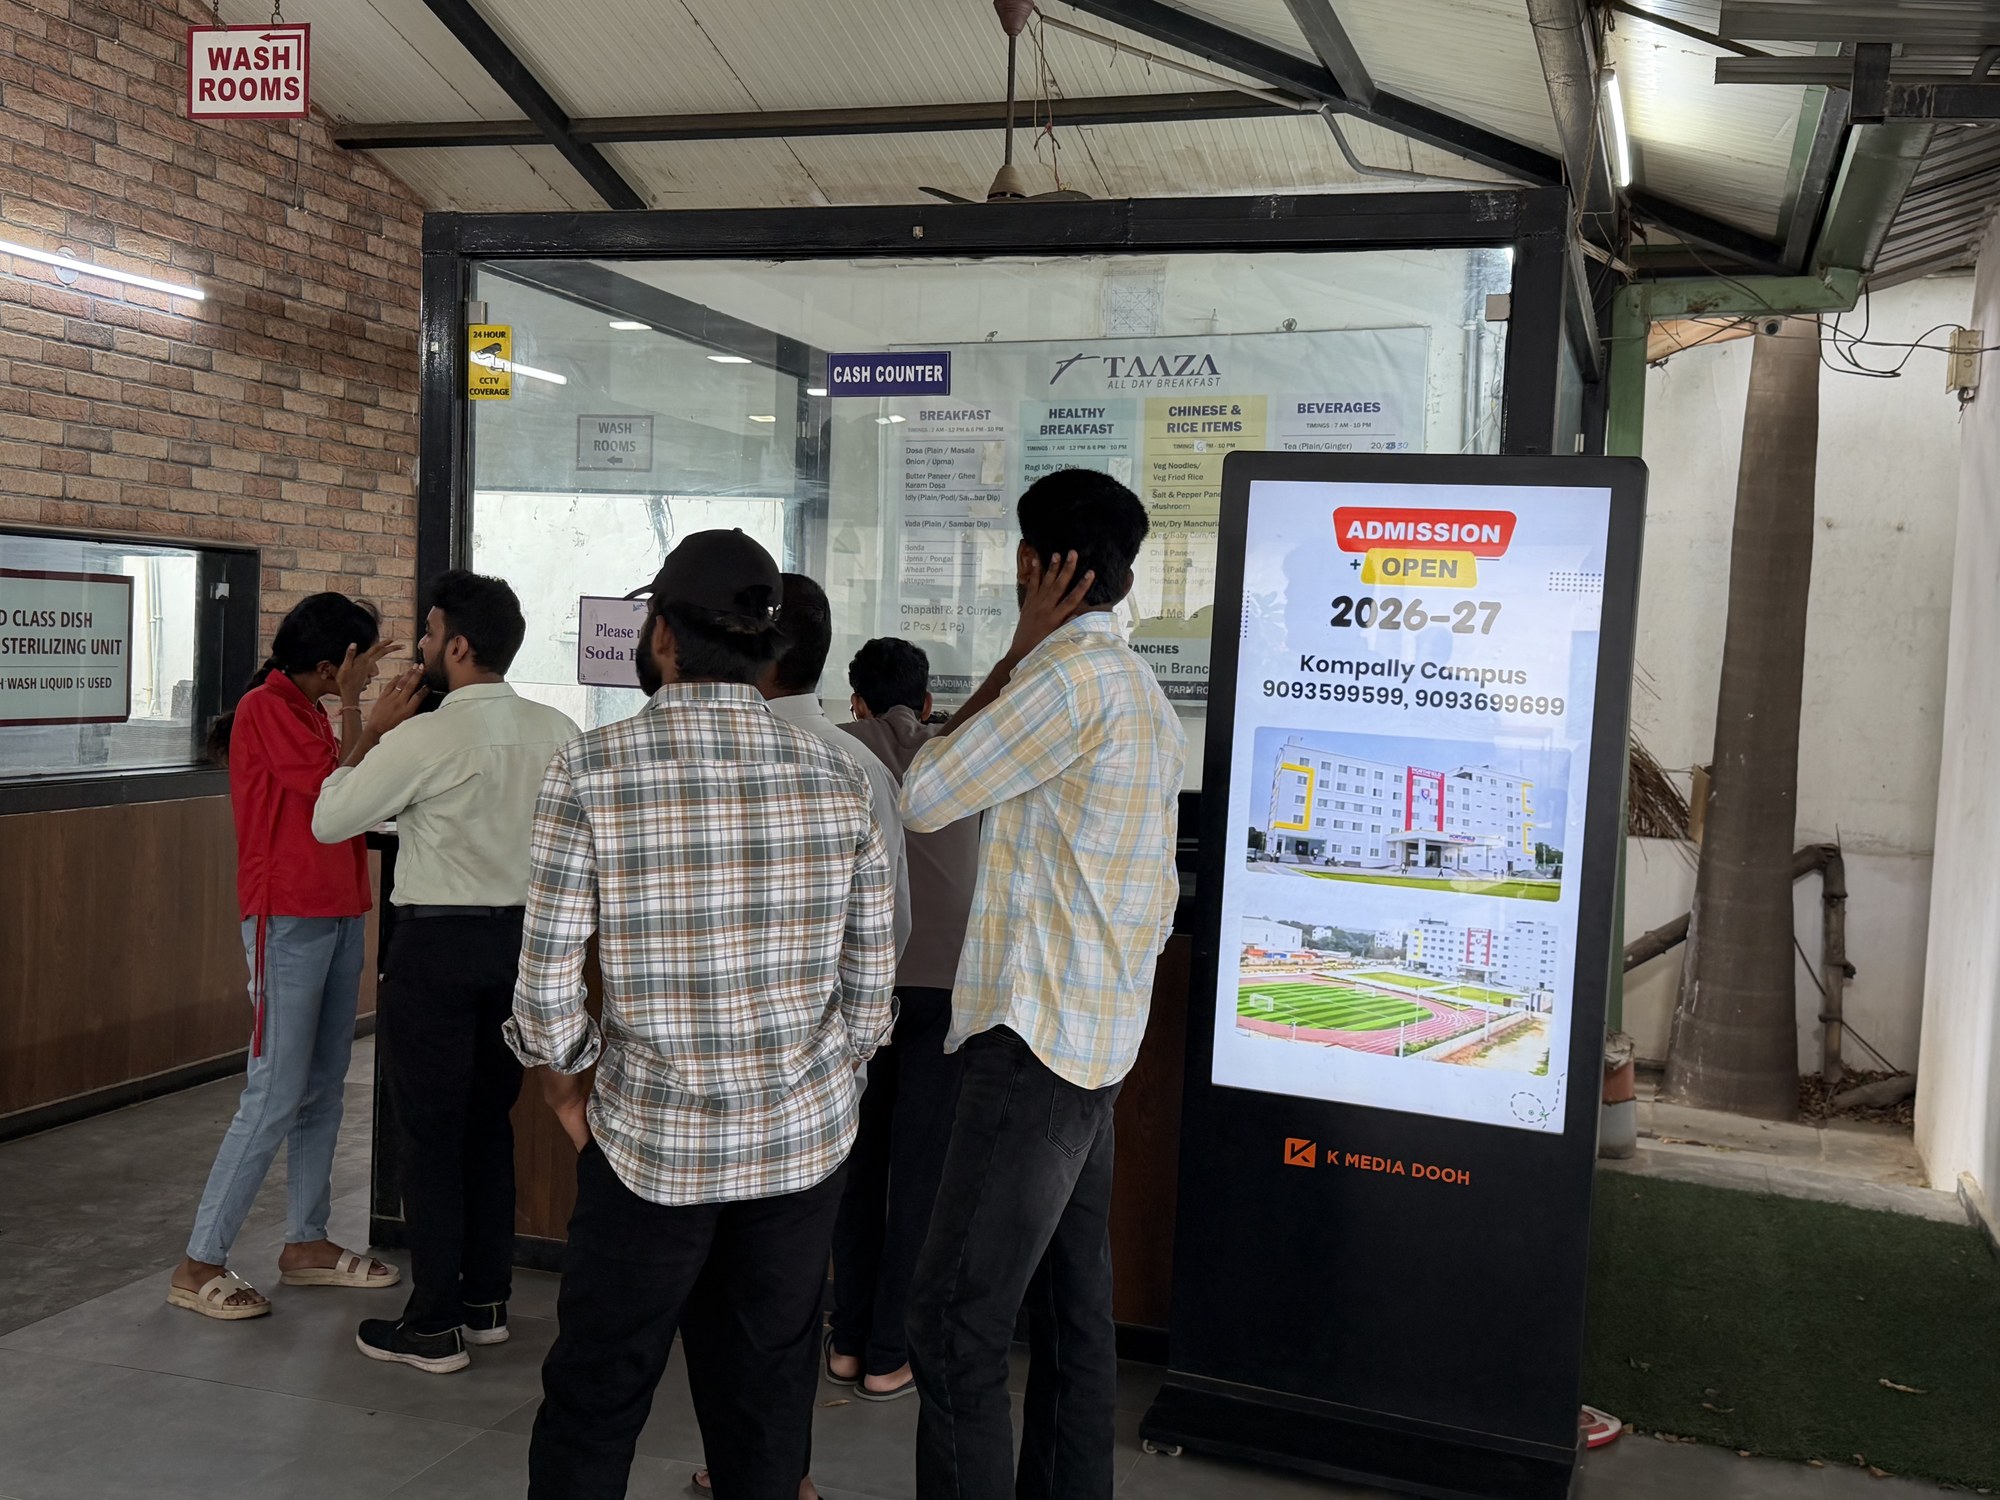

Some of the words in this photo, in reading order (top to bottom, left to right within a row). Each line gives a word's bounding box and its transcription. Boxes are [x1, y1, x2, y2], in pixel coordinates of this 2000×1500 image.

[207, 46, 290, 71] WASH
[198, 76, 300, 102] ROOMS
[483, 331, 506, 339] HOUR
[1103, 353, 1222, 379] TAAZA
[833, 366, 871, 383] CASH
[875, 365, 943, 383] COUNTER
[479, 377, 500, 385] CCTV
[1107, 379, 1126, 389] ALL
[1131, 379, 1153, 389] DAY
[1156, 377, 1222, 388] BREAKFAST
[469, 388, 510, 396] COVERAGE
[1048, 408, 1106, 419] HEALTHY
[1168, 405, 1228, 417] CHINESE
[1230, 404, 1242, 415] &
[1297, 402, 1381, 414] BEVERAGES
[919, 409, 992, 421] BREAKFAST
[598, 422, 632, 434] WASH
[1040, 424, 1114, 435] BREAKFAST
[1167, 422, 1198, 433] RICE
[1201, 421, 1242, 433] ITEMS
[593, 440, 636, 452] ROOMS
[1283, 442, 1297, 450] Tea
[1298, 442, 1353, 450] (Plain/Ginger)
[932, 458, 955, 466] Upma)
[1153, 462, 1166, 471] Veg
[905, 472, 926, 480] Butter
[958, 472, 976, 480] Ghee
[1153, 474, 1166, 482] Veg
[986, 494, 1001, 502] Dip)
[1152, 491, 1166, 499] Salt
[1176, 491, 1202, 499] Pepper
[904, 520, 921, 528] Vada
[922, 520, 941, 528] (Plain
[948, 520, 975, 528] Sambar
[976, 520, 991, 529] Dip)
[1151, 520, 1182, 529] Wet/Dry
[1346, 520, 1502, 544] ADMISSION
[1381, 557, 1458, 579] OPEN
[900, 605, 943, 616] Chapathi
[957, 606, 964, 615] 2
[966, 606, 1002, 616] Curries
[1329, 595, 1502, 635] 2026-27
[12, 609, 56, 628] CLASS
[60, 611, 93, 628] DISH
[595, 623, 634, 638] Please
[900, 621, 910, 632] (2
[913, 621, 931, 631] Pcs
[940, 622, 947, 631] 1
[949, 622, 965, 633] Pc)
[1, 637, 87, 655] STERILIZING
[91, 638, 122, 655] UNIT
[1128, 644, 1179, 654] ANCHES
[585, 645, 625, 661] Soda
[1171, 662, 1209, 675] Branc
[1299, 654, 1416, 683] Kompally
[1420, 661, 1528, 689] Campus
[7, 677, 37, 690] WASH
[40, 677, 73, 691] LIQUID
[76, 677, 85, 689] IS
[88, 677, 112, 689] USED
[1262, 679, 1409, 710] 9093599599,
[1414, 689, 1566, 716] 9093699699
[1326, 1150, 1340, 1166] K
[1345, 1152, 1406, 1176] MEDIA
[1411, 1162, 1471, 1186] DOOH
